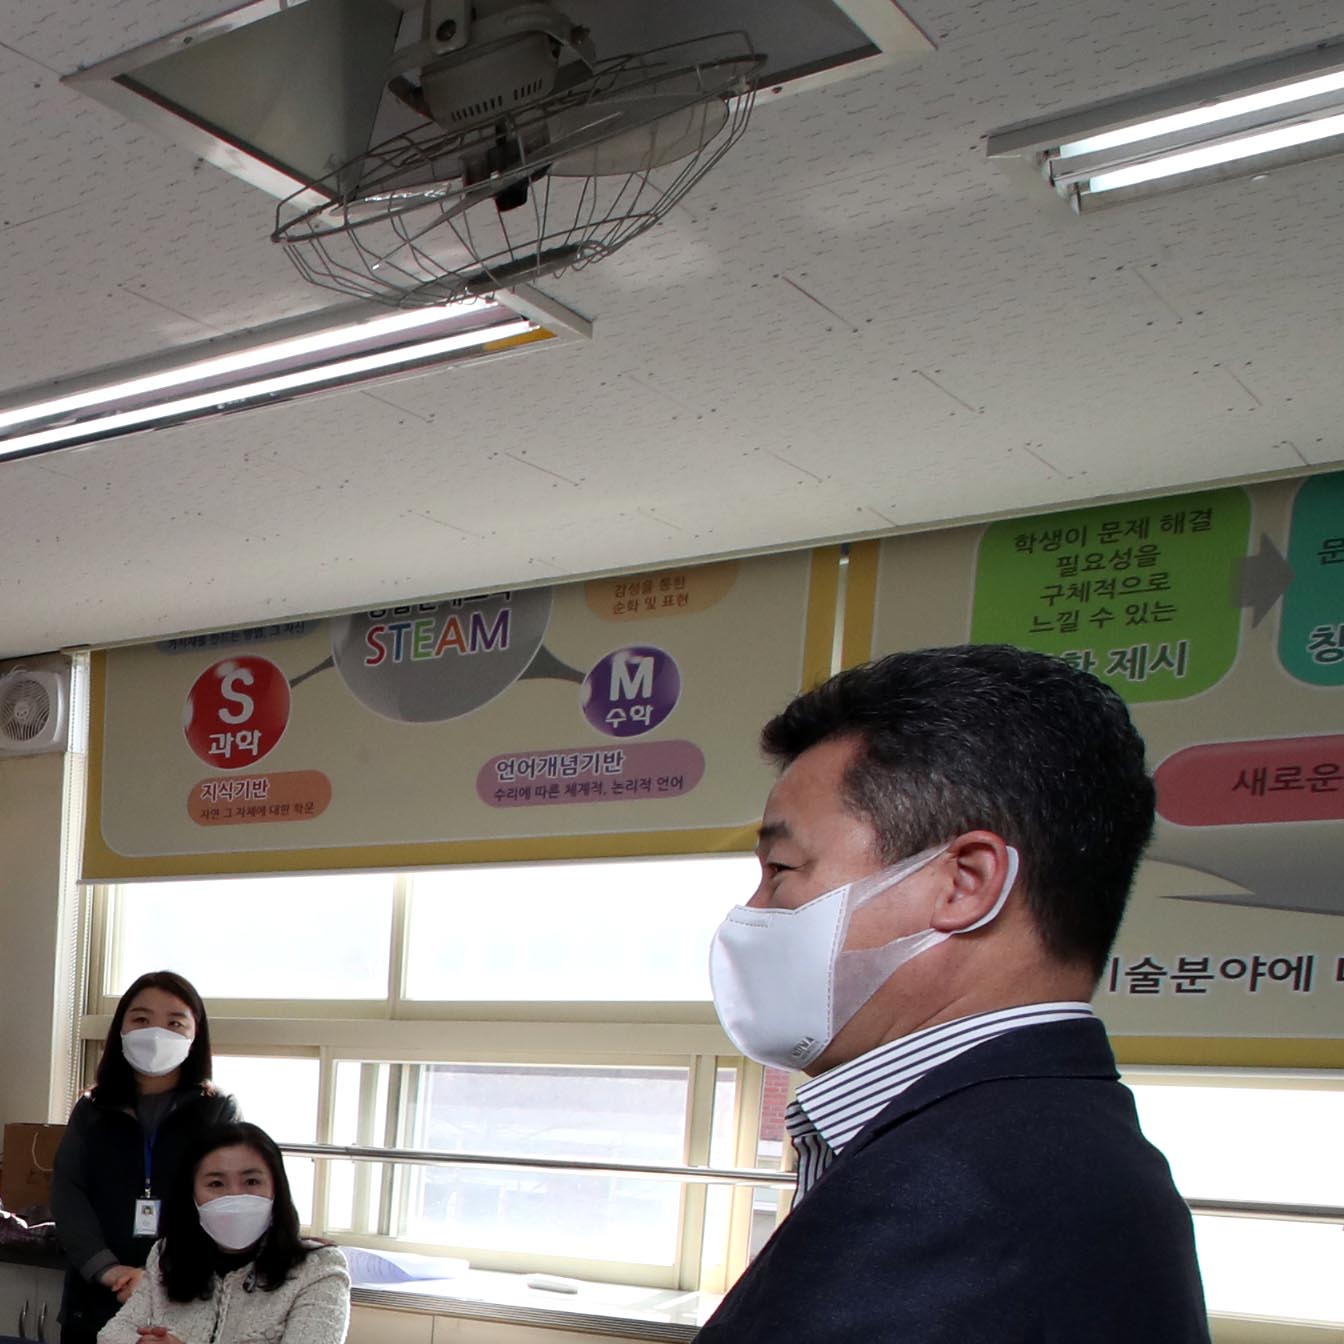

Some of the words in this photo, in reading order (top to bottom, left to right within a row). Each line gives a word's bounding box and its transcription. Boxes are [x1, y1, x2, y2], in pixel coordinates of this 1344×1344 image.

[1015, 526, 1087, 554] 학생이
[1097, 517, 1151, 543] 문제
[1160, 508, 1213, 534] 해결
[1056, 544, 1161, 577] 필요성을
[615, 579, 653, 598] 감성을
[662, 593, 689, 608] 표현
[1040, 572, 1171, 606] 구체적으로
[1029, 610, 1080, 633] 느낄
[1089, 607, 1115, 629] 수
[1125, 601, 1177, 626] 있는
[365, 609, 511, 665] STEAM
[1107, 641, 1189, 681] 제시
[610, 655, 655, 701] M
[218, 668, 255, 724] S
[605, 705, 654, 729] 수학
[208, 730, 262, 759] 과학
[496, 750, 624, 781] 언어개념기반
[1232, 763, 1344, 796] 새로운
[201, 778, 270, 802] 지식기반
[494, 785, 531, 802] 수리에
[535, 783, 560, 799] 따른
[611, 777, 652, 794] 논리적
[657, 775, 684, 792] 언어
[223, 808, 233, 818] 그
